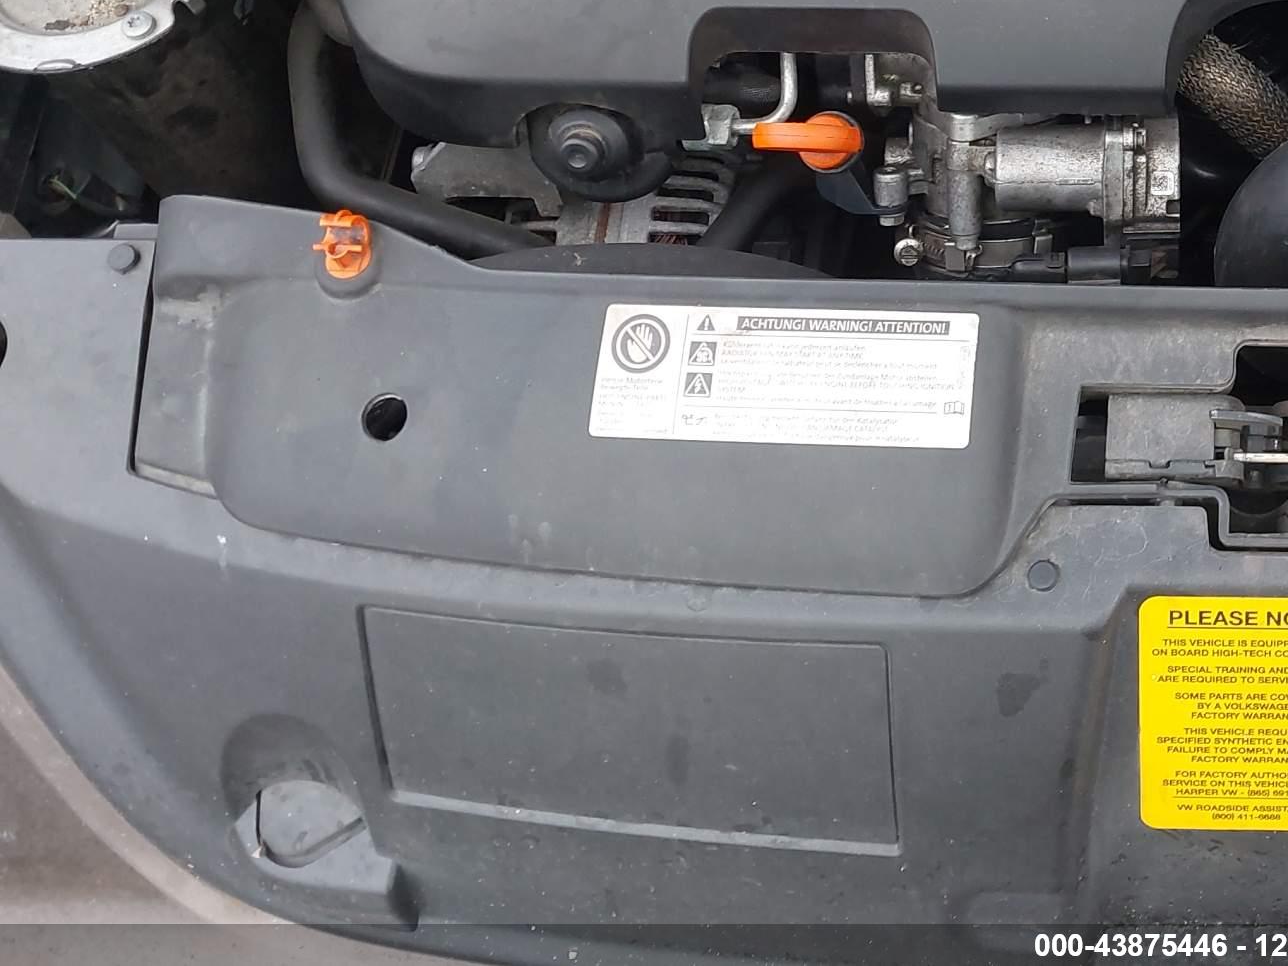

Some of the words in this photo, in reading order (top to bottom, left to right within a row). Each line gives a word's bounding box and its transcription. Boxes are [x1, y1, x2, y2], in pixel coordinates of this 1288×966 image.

[741, 318, 805, 331] ACHTUNG!
[808, 320, 872, 333] WARNING!
[875, 322, 946, 335] ATTENTION!
[1170, 610, 1258, 626] PLEASE
[1162, 638, 1187, 647] THIS
[1189, 638, 1235, 648] VEHICLE
[1237, 639, 1248, 648] IS
[1151, 648, 1168, 657] ON
[1170, 648, 1210, 657] BOARD
[1211, 649, 1272, 658] HIGH-TECH
[1167, 665, 1213, 674] SPECIAL
[1215, 665, 1266, 675] TRAINING
[1156, 675, 1180, 683] ARE
[1181, 675, 1238, 684] REQUIRED
[1240, 675, 1256, 684] TO
[1174, 692, 1206, 701] SOME
[1208, 692, 1244, 701] PARTS
[1245, 693, 1268, 701] ARE
[1197, 702, 1212, 710] BY
[1214, 702, 1222, 710] A
[1191, 711, 1241, 720] FACTORY
[1183, 727, 1208, 736] THIS
[1209, 727, 1255, 736] VEHICLE
[1156, 736, 1212, 745] SPECIFIED
[1213, 737, 1273, 746] SYNTHETIC
[1166, 745, 1211, 754] FAILURE
[1213, 746, 1228, 754] TO
[1230, 746, 1275, 755] COMPLY
[1191, 755, 1240, 763] FACTORY
[1175, 770, 1197, 778] FOR
[1199, 770, 1248, 779] FACTORY
[1162, 778, 1208, 787] SERVICE
[1209, 779, 1226, 788] ON
[1227, 780, 1252, 788] THIS
[1175, 788, 1219, 796] HARPER
[1221, 788, 1238, 796] VW
[1176, 803, 1194, 811] VW
[1195, 804, 1250, 812] ROADSIDE
